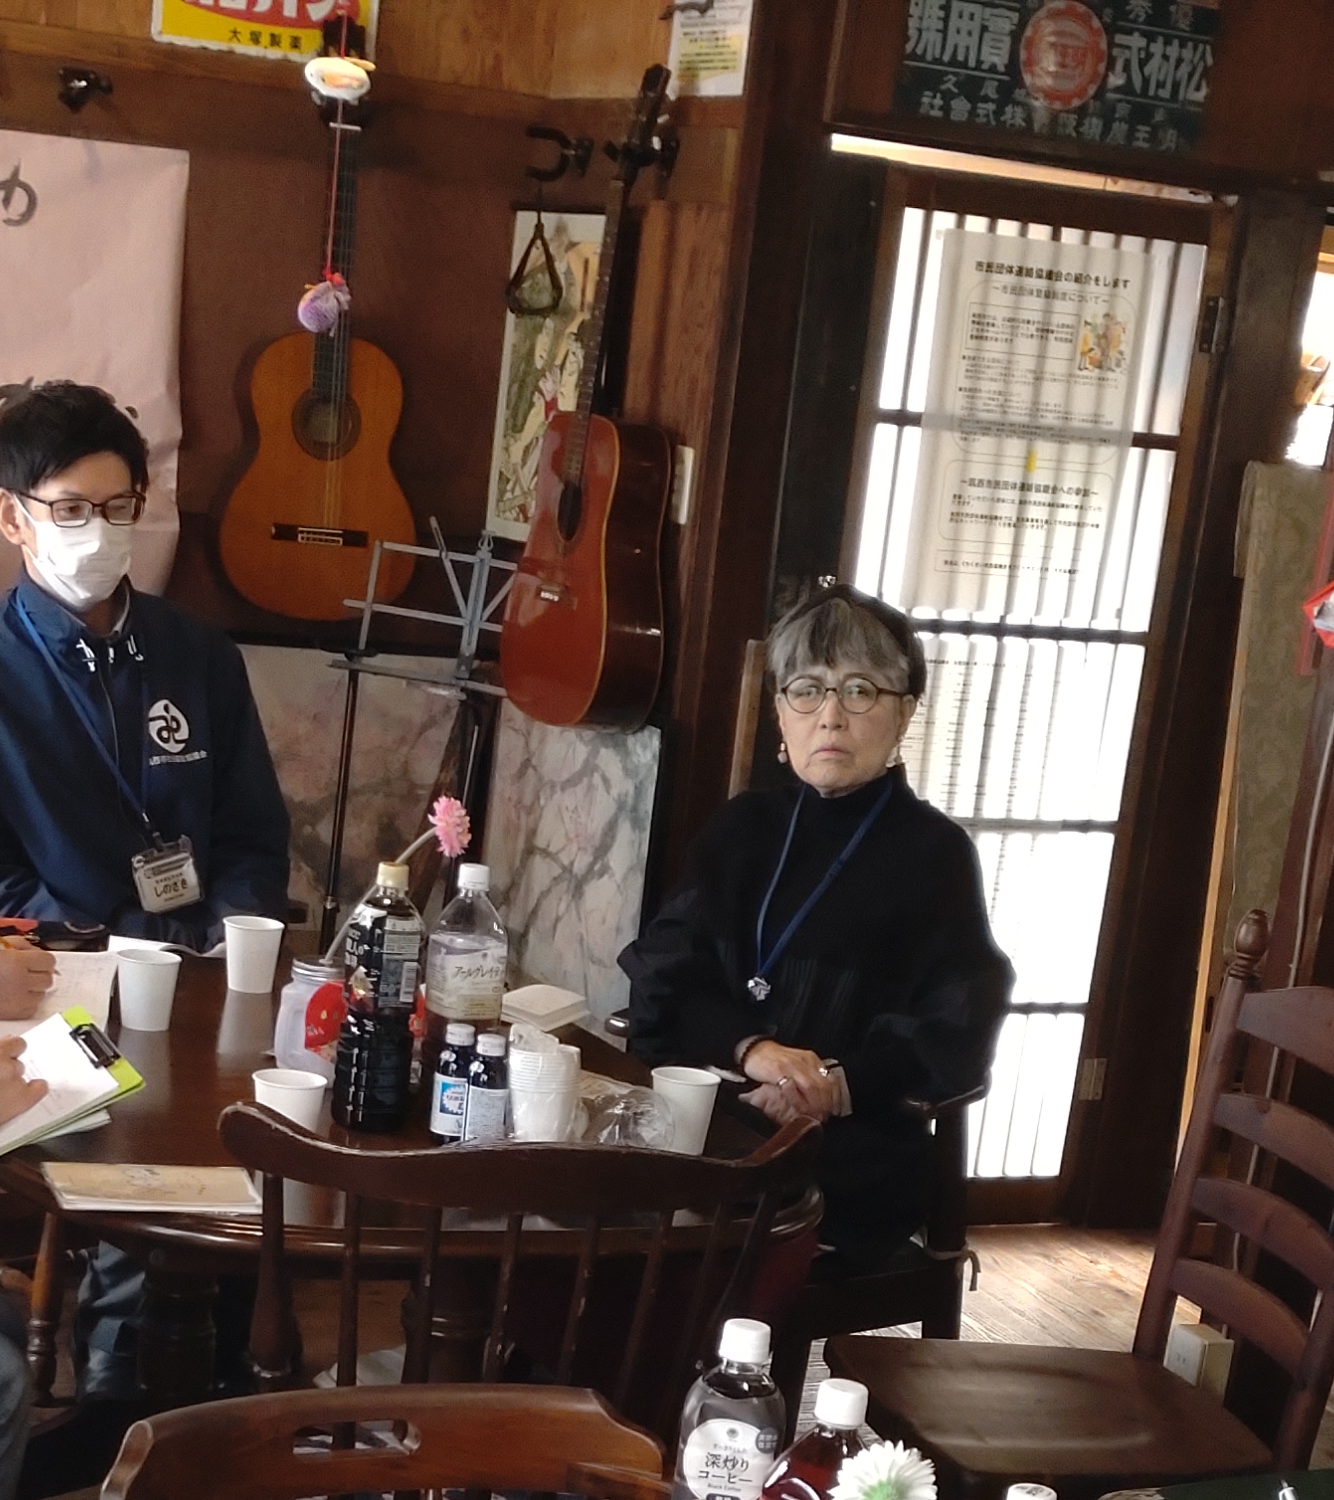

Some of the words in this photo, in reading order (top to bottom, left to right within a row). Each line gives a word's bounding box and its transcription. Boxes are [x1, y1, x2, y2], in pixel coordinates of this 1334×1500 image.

[227, 27, 304, 51] 大塚製薬
[154, 878, 188, 898] しのざき
[697, 1470, 754, 1485] コーヒー
